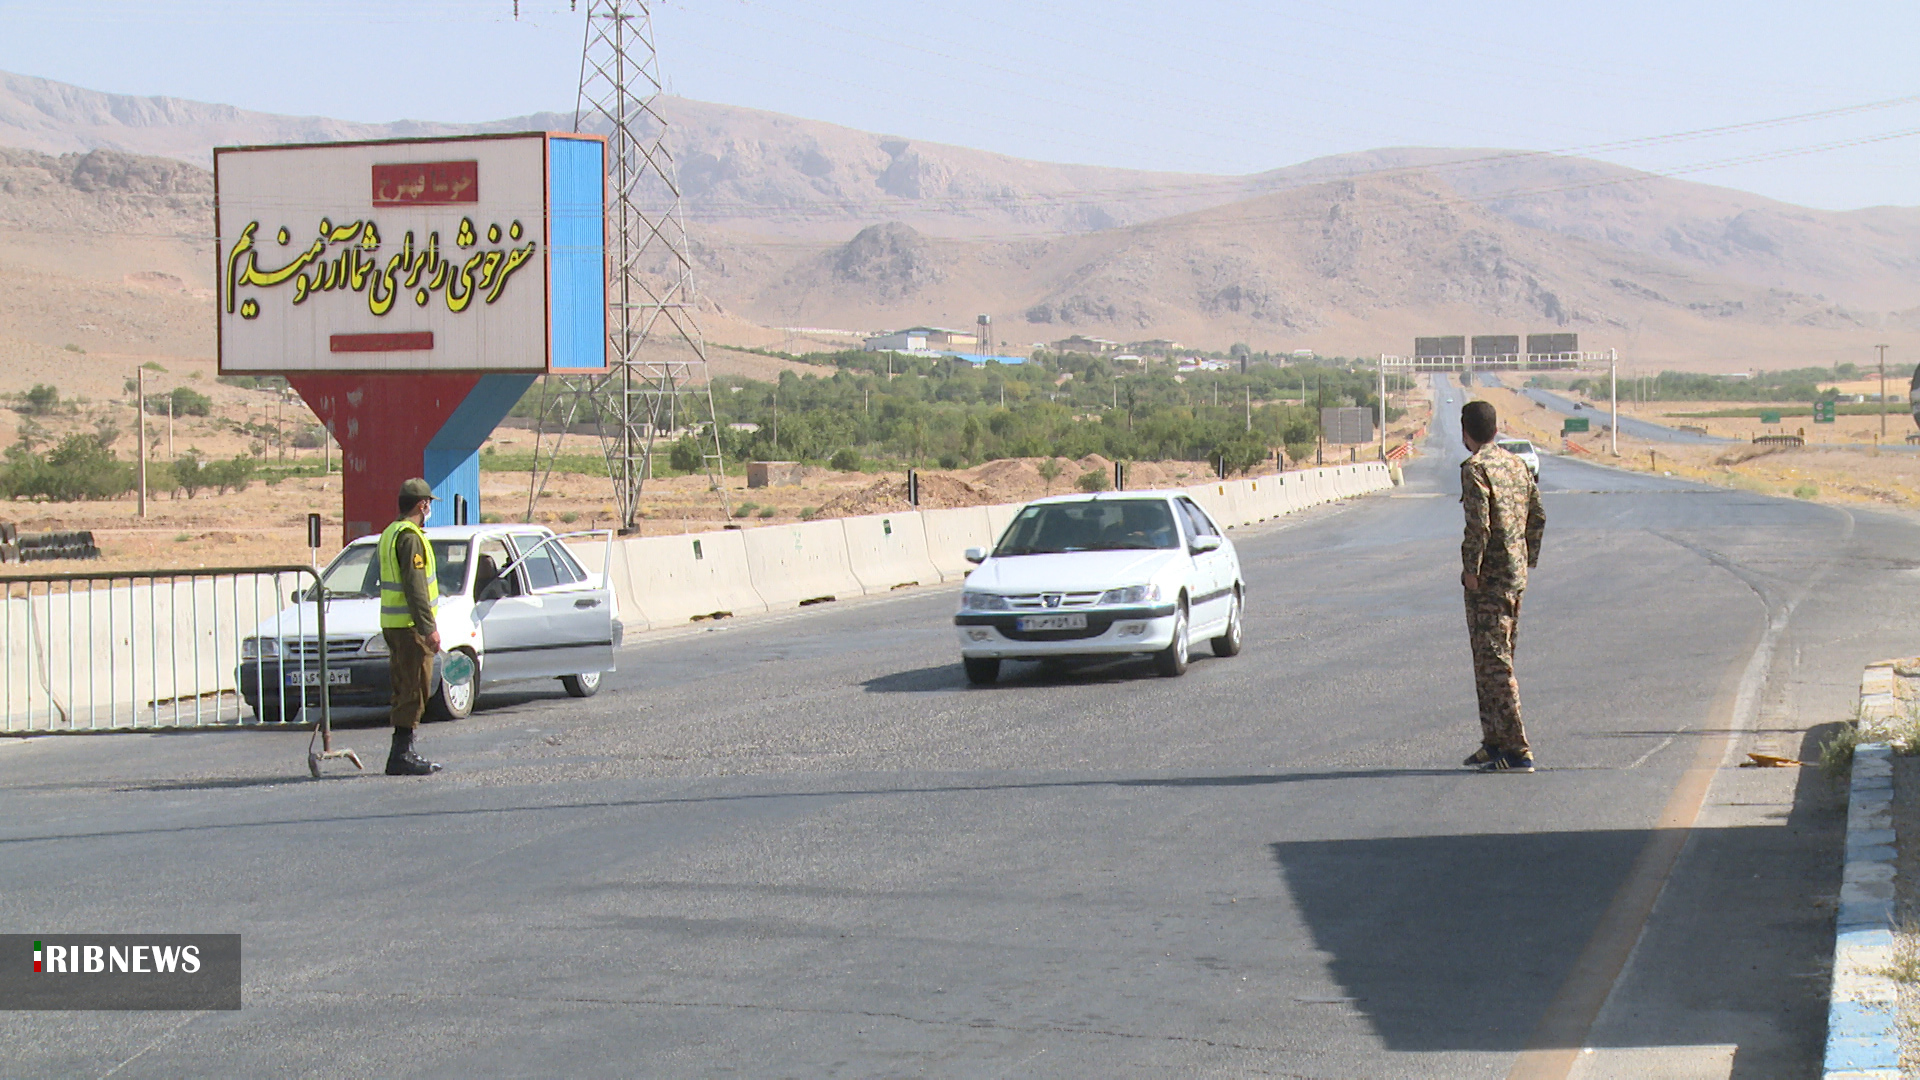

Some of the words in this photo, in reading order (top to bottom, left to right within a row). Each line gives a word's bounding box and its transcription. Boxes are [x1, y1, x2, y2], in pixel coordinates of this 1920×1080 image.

[226, 218, 363, 318] آرزومندیم
[351, 220, 381, 291] شما
[368, 231, 429, 315] برای
[428, 231, 449, 290] را
[445, 217, 503, 312] خوشی
[485, 221, 536, 304] سفر
